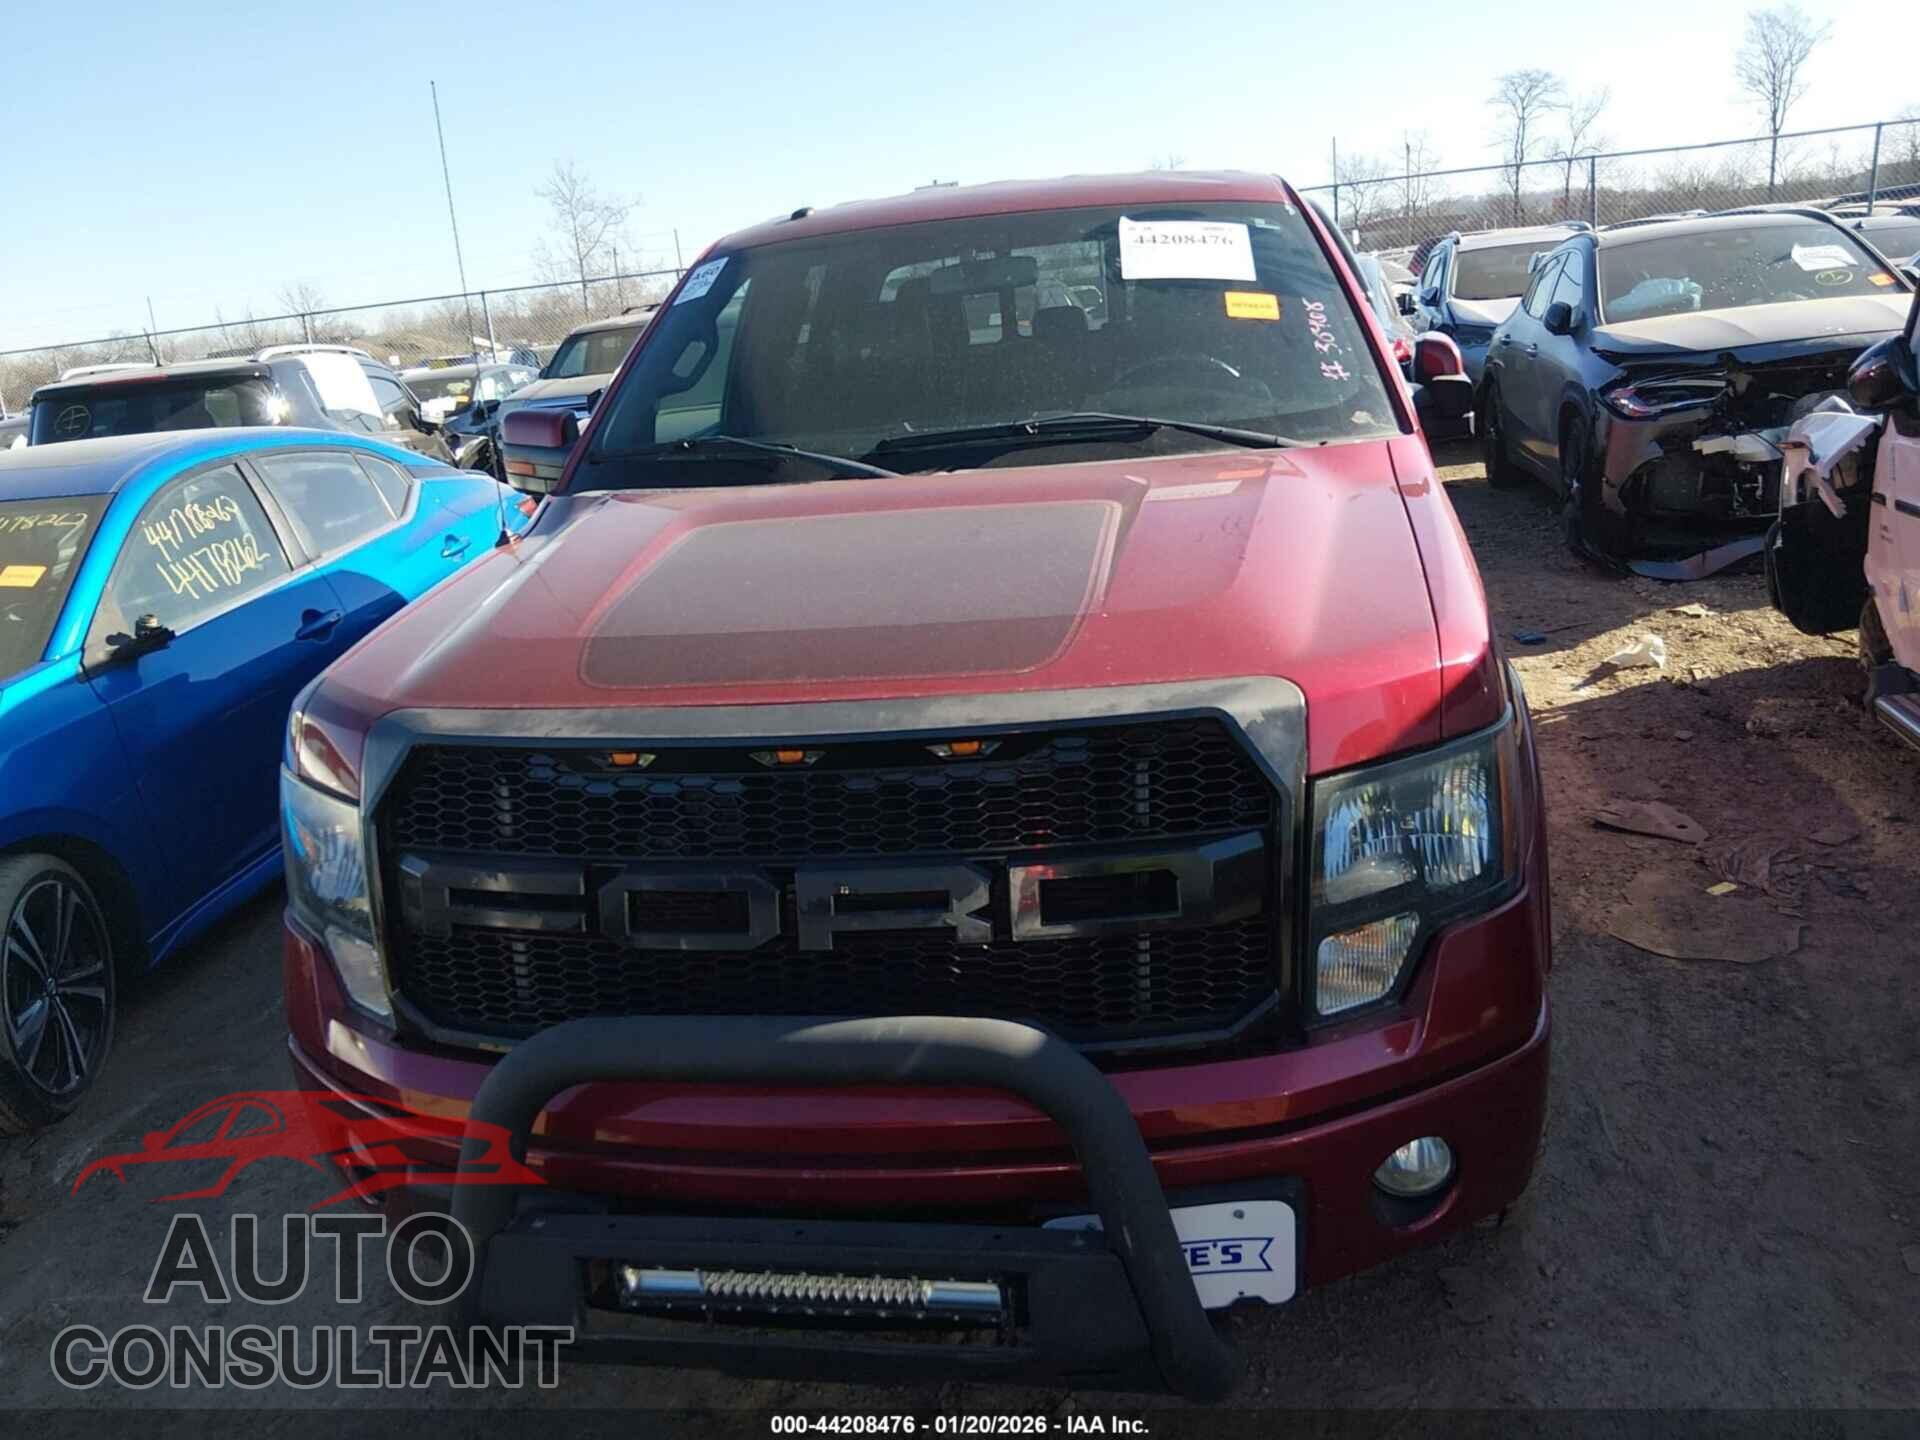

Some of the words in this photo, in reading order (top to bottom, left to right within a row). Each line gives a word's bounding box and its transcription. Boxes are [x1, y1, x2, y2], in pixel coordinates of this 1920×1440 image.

[1133, 233, 1234, 246] 44208476
[404, 842, 1238, 950] FORD
[1183, 1242, 1243, 1267] E'S
